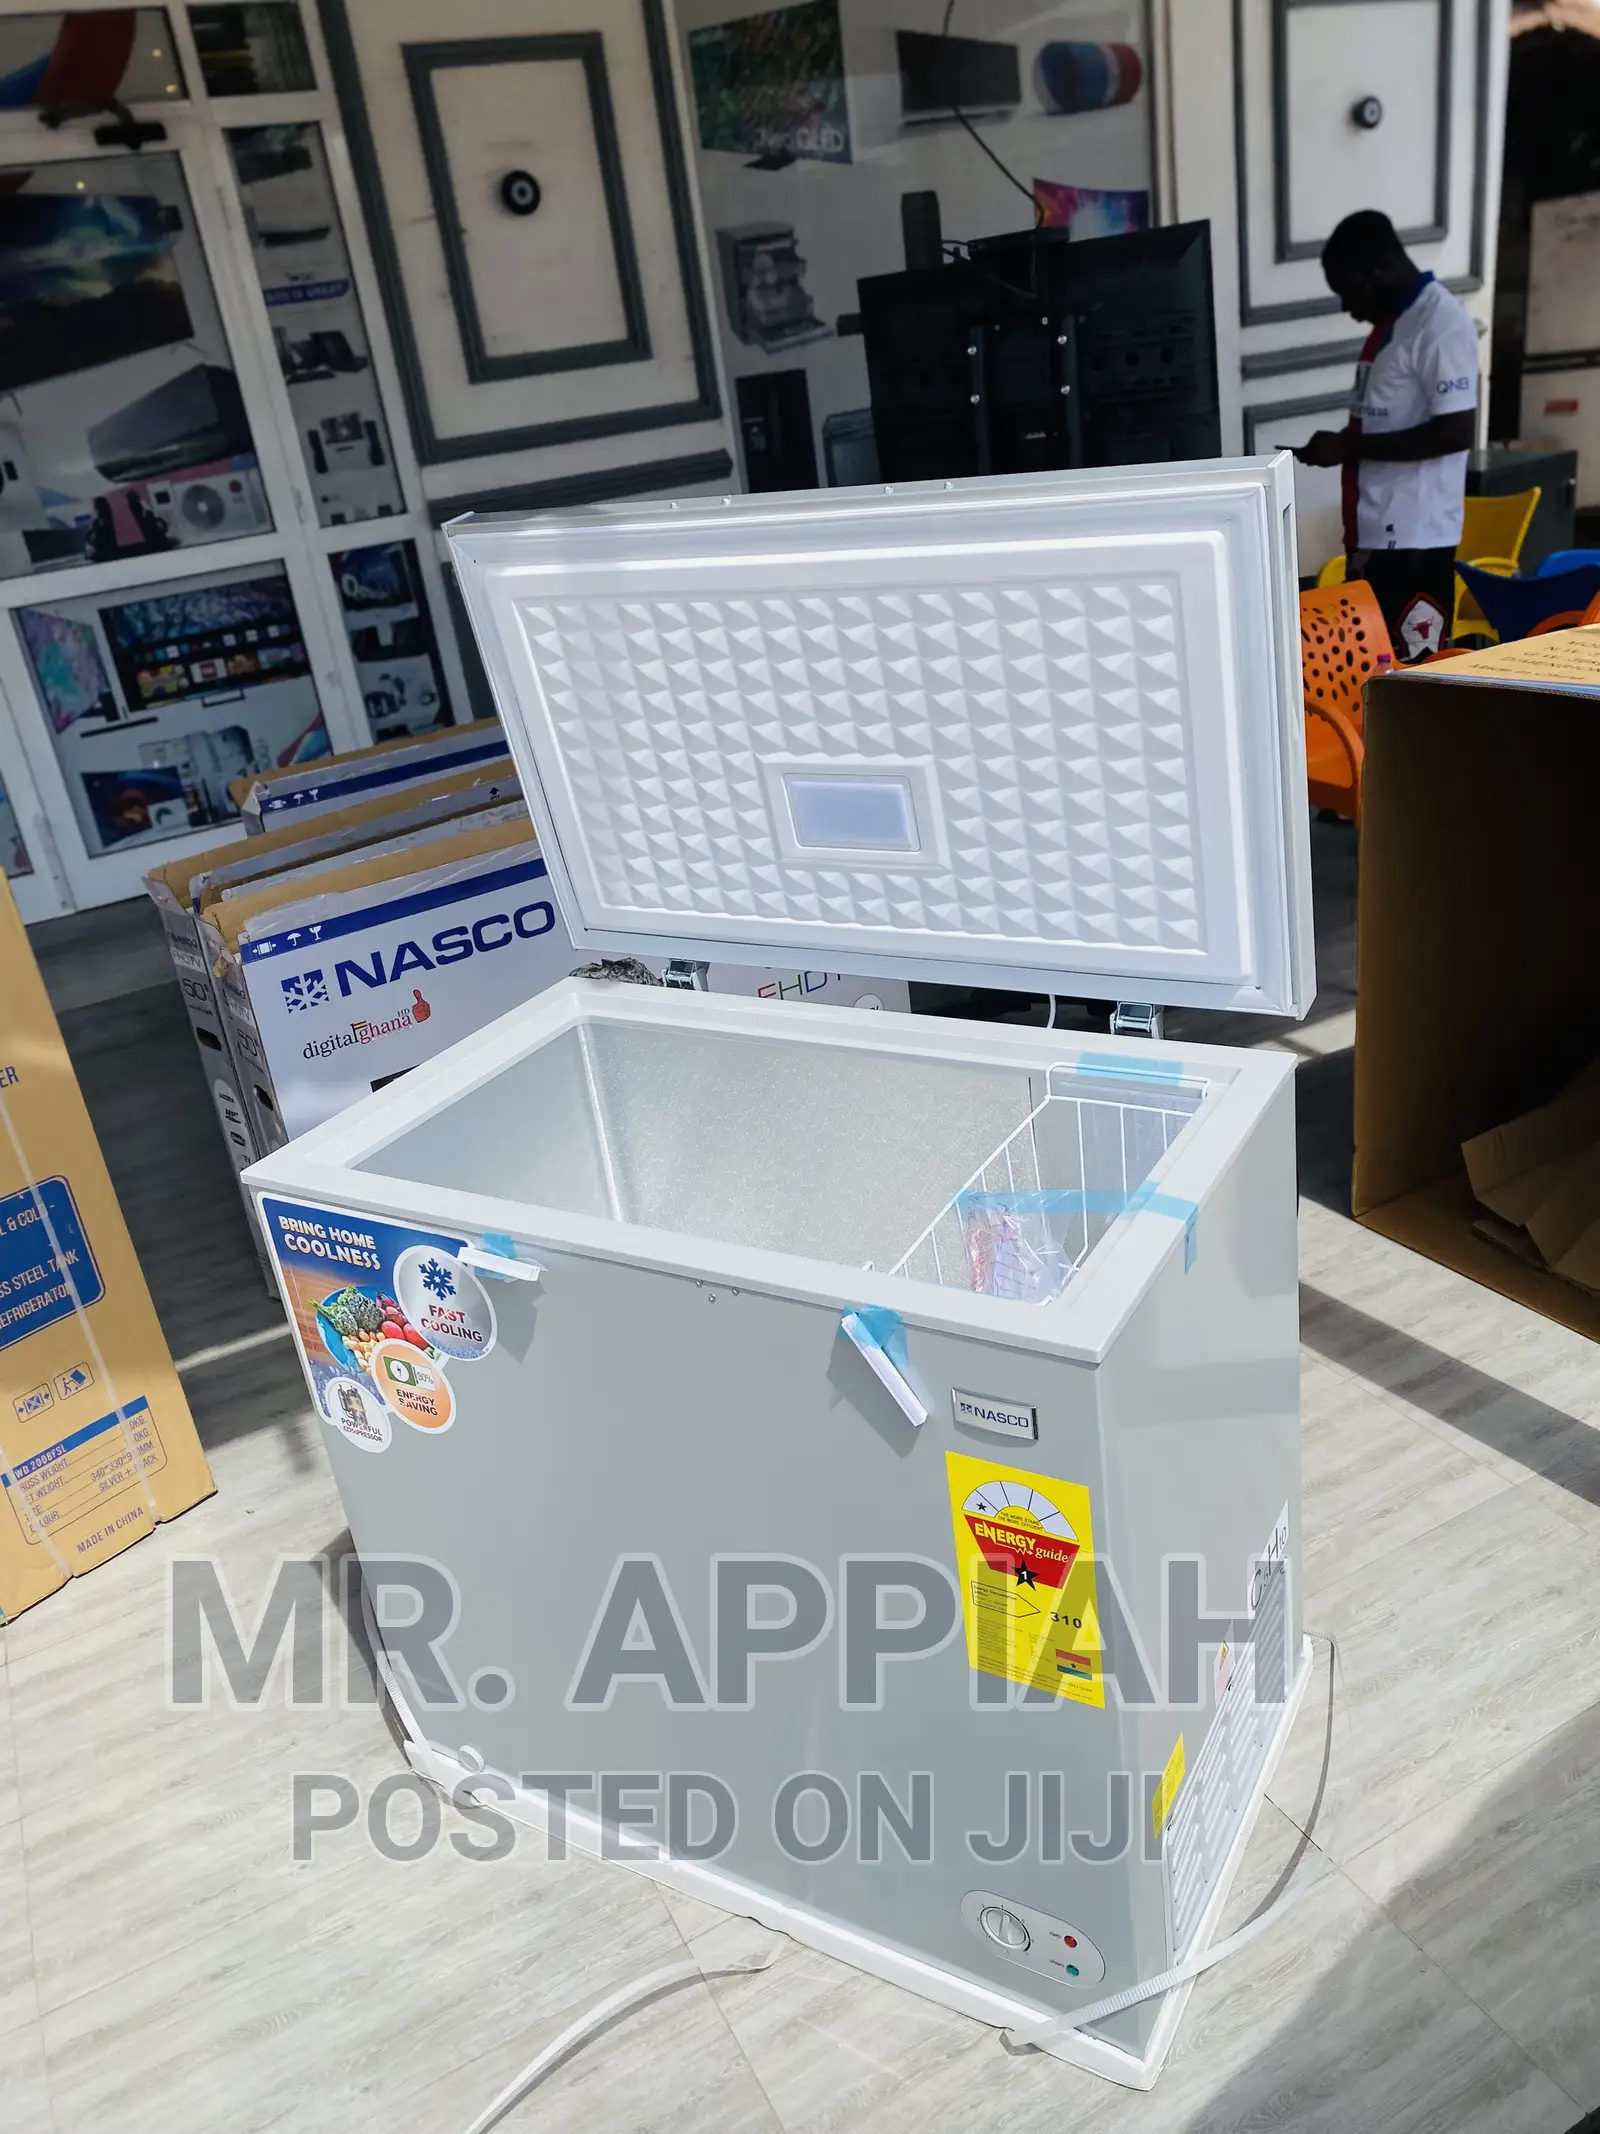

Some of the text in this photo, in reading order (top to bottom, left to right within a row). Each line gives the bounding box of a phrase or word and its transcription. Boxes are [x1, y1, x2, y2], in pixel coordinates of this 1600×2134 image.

[334, 900, 556, 998] NASCO
[6, 1216, 18, 1232] &
[277, 1215, 376, 1250] BRING HOME
[284, 1233, 381, 1271] COOLNESS
[11, 1263, 49, 1292] STEEL
[46, 1248, 80, 1274] TANK
[428, 1304, 466, 1324] FAST
[421, 1317, 483, 1342] COOLING
[396, 1388, 435, 1406] ENERGY
[398, 1397, 438, 1416] SAVING
[341, 1417, 383, 1437] POWERFUL
[974, 1406, 1030, 1428] NASCO
[98, 1471, 124, 1493] SILVER
[76, 1506, 145, 1554] MADE IN CHINA
[973, 1520, 1037, 1551] ENERGY
[1035, 1546, 1069, 1564] guide
[1021, 1570, 1029, 1580] 1
[1049, 1610, 1083, 1629] 310
